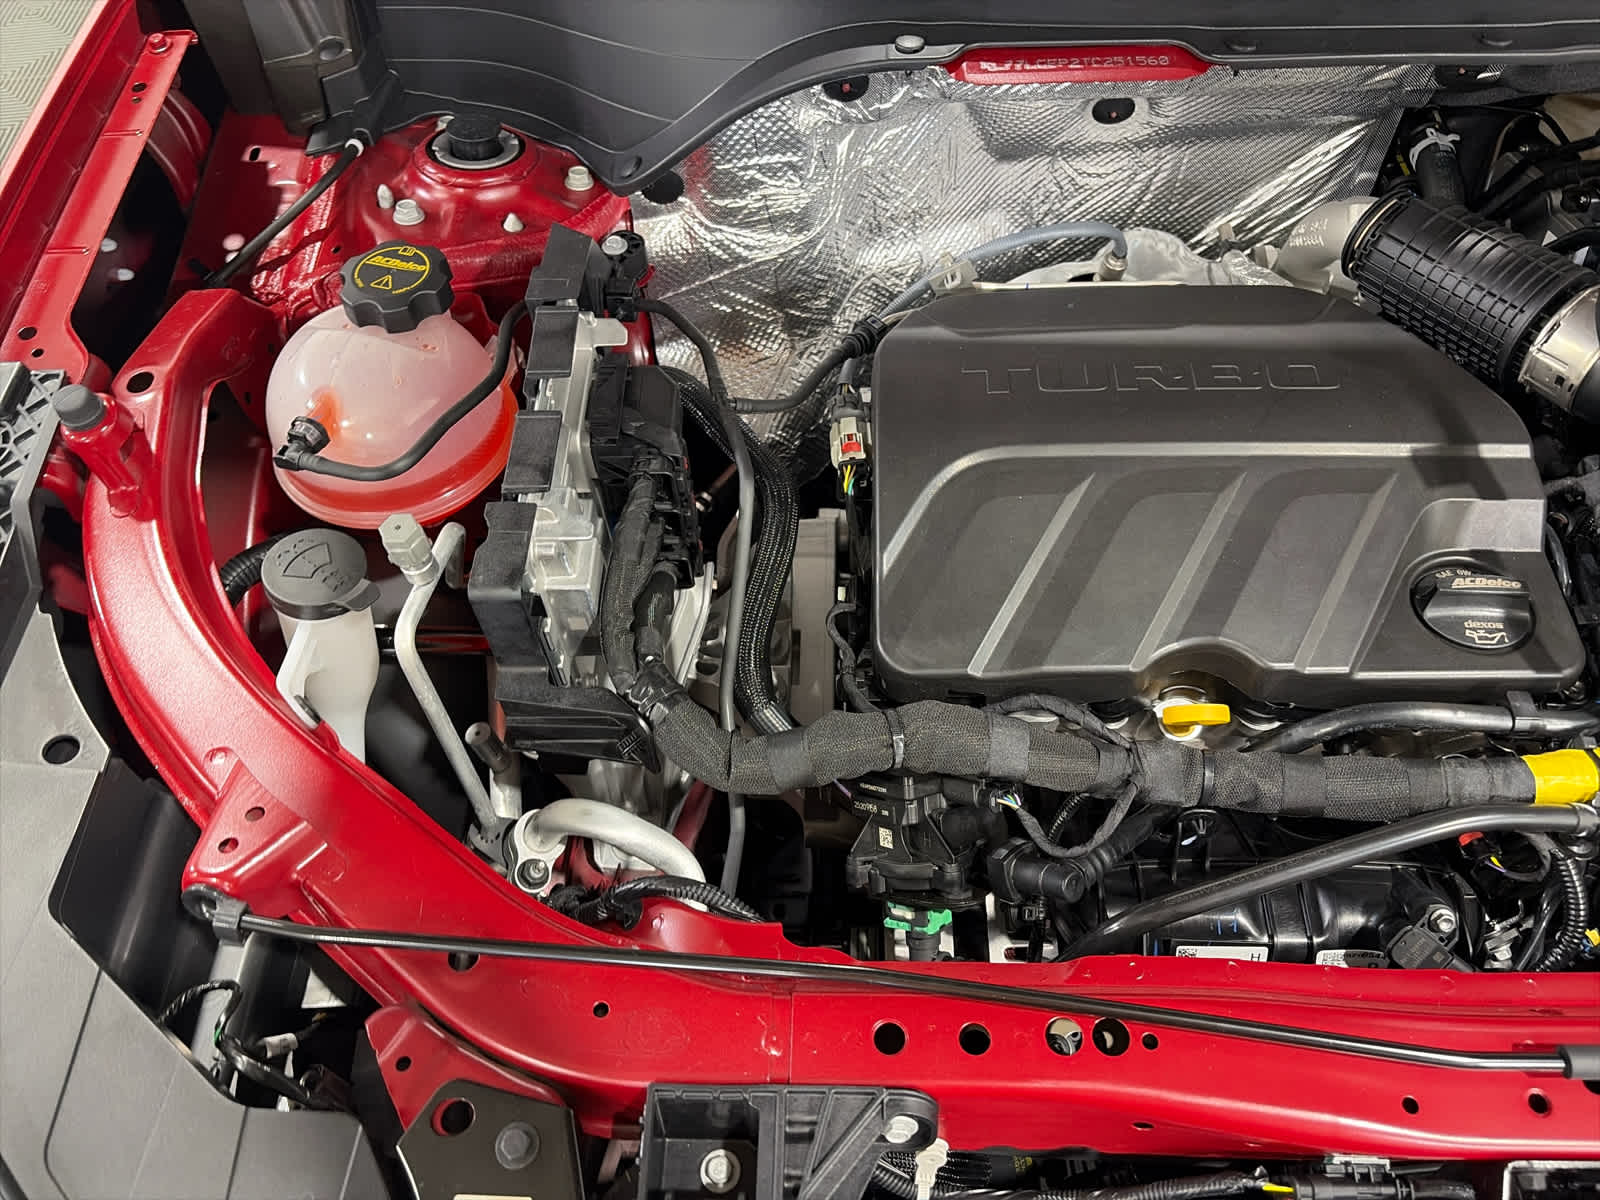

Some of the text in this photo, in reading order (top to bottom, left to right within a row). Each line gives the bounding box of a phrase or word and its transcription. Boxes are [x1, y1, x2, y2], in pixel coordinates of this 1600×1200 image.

[960, 362, 1341, 394] TURBO
[1451, 577, 1522, 589] ACDelco
[1464, 619, 1504, 629] dexos
